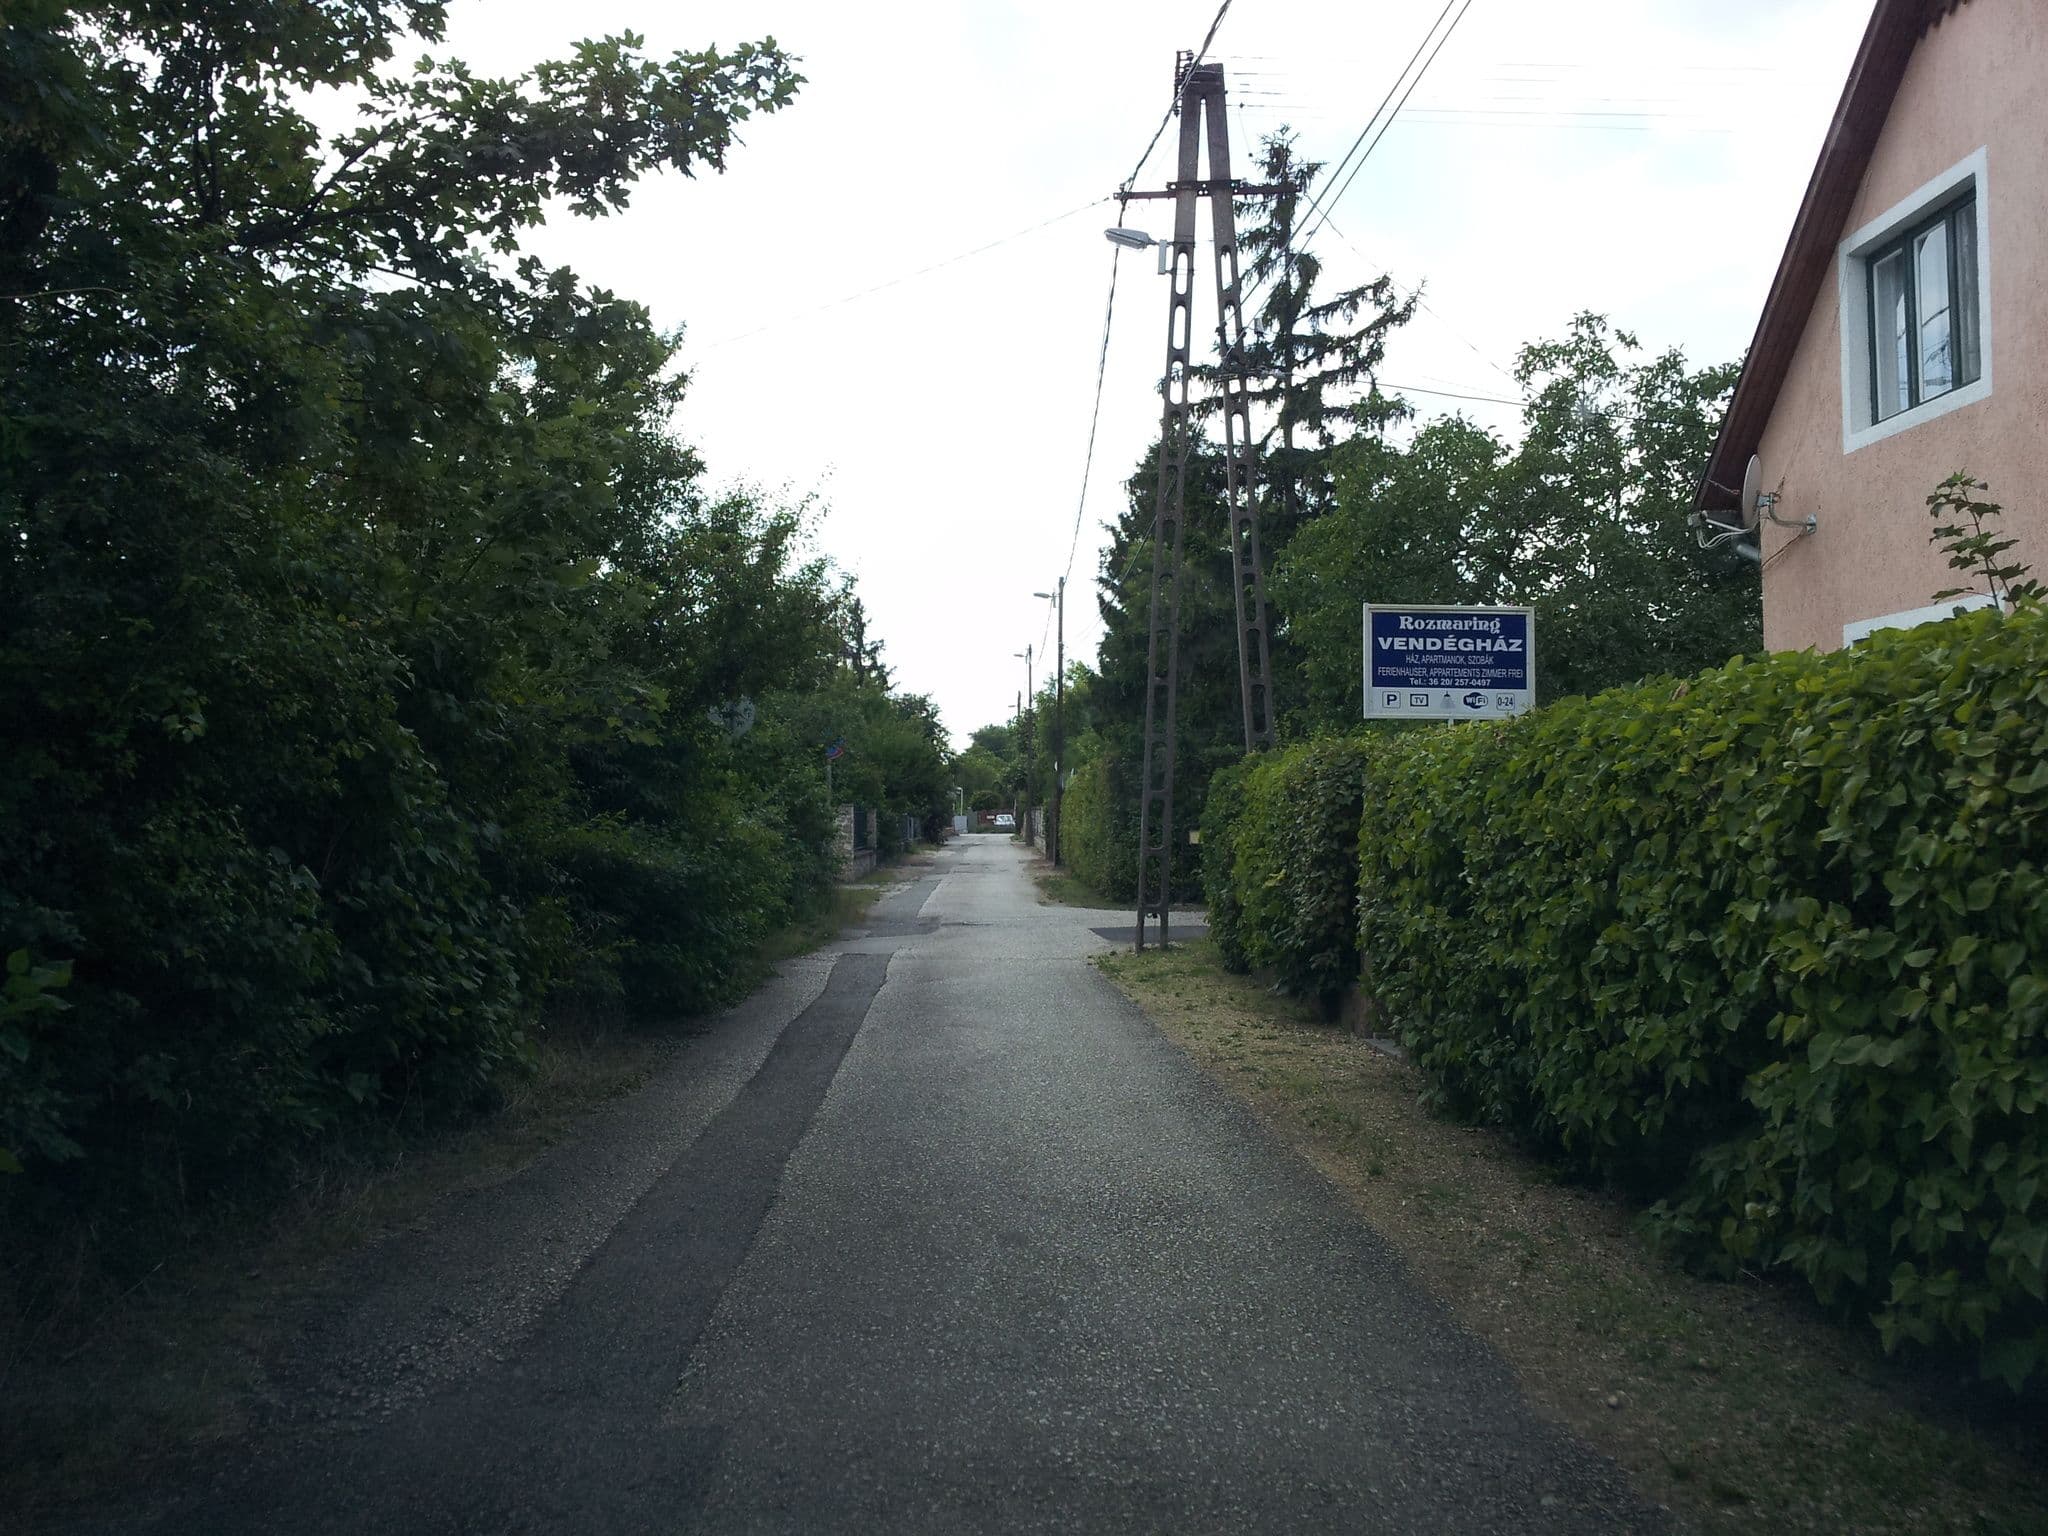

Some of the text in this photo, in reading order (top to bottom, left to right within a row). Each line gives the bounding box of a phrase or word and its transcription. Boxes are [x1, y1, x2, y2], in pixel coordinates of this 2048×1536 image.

[1399, 616, 1500, 634] Rozmaring
[1378, 635, 1523, 651] VENDÉGHÁZ
[1468, 654, 1493, 664] SZOBÁK
[1508, 669, 1523, 678] FREI
[1386, 695, 1397, 705] P
[1498, 696, 1514, 706] 0-24
